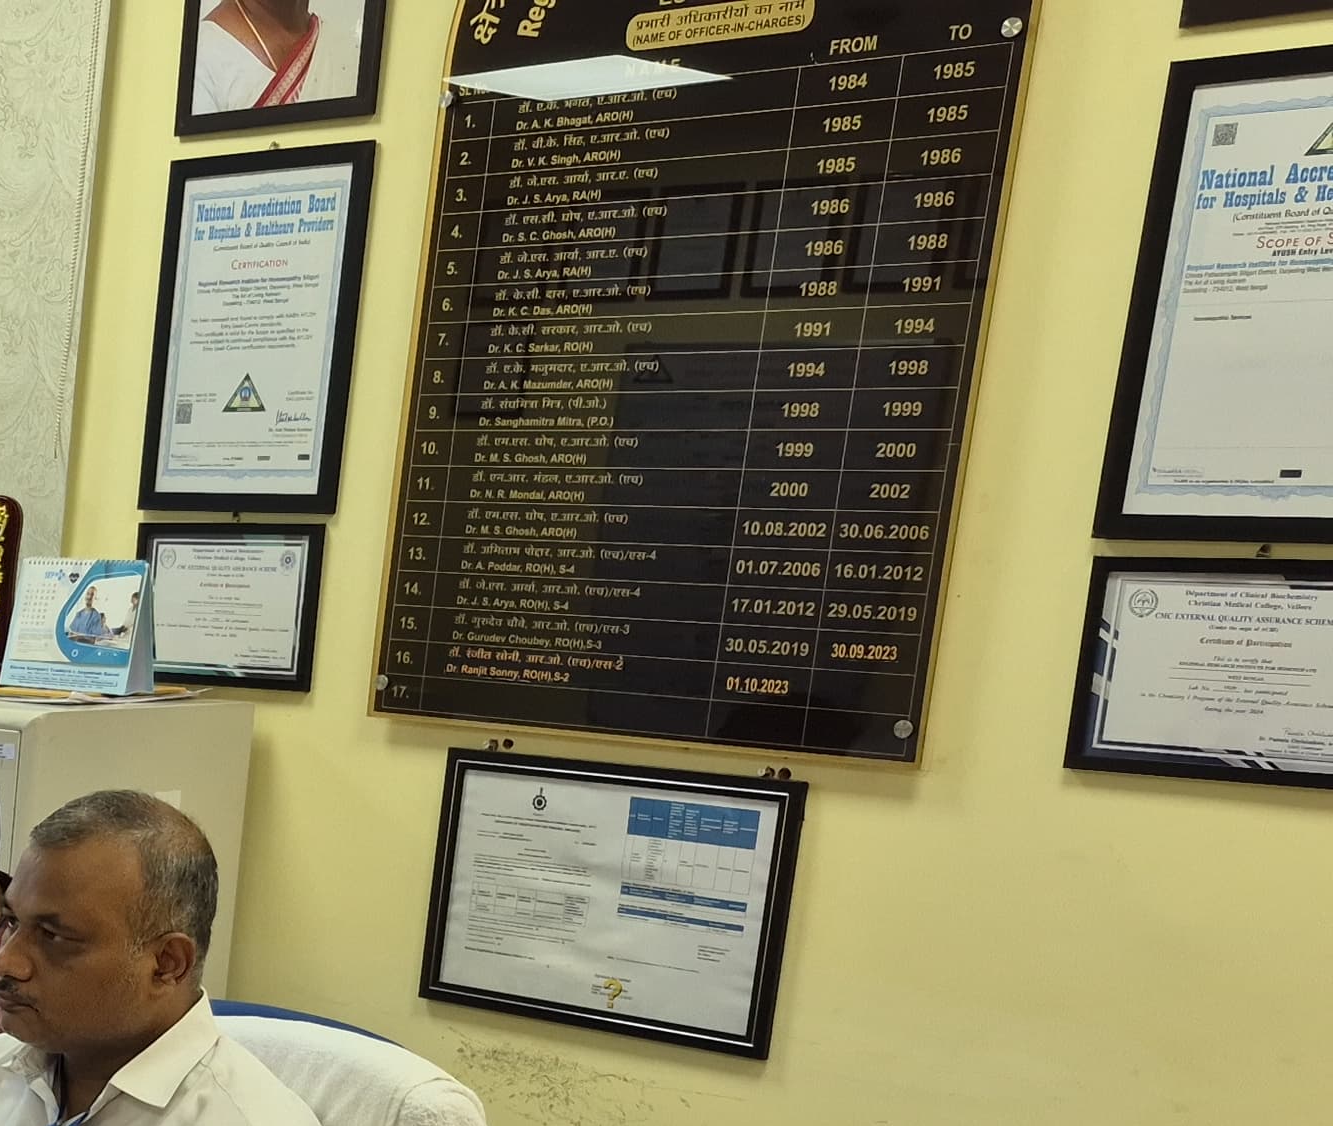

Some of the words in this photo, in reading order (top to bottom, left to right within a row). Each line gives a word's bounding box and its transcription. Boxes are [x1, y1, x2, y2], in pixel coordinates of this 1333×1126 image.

[636, 14, 670, 31] प्रभारी
[755, 4, 771, 15] का
[632, 31, 665, 47] (NAME
[668, 28, 682, 41] OF
[685, 14, 805, 39] OFFICER-IN-CHARGES)
[948, 24, 973, 40] TO
[829, 35, 878, 55] FROM
[933, 60, 976, 81] 1985
[828, 72, 868, 92] 1984
[464, 113, 476, 129] 1.
[515, 120, 530, 131] Dr.
[556, 114, 594, 128] Bhagat,
[595, 109, 634, 124] ARO(H)
[927, 104, 969, 123] 1985
[822, 114, 862, 133] 1985
[459, 151, 472, 166] 2.
[510, 158, 525, 169] Dr.
[550, 153, 582, 166] Singh,
[582, 149, 621, 163] ARO(H)
[920, 147, 962, 166] 1986
[816, 156, 857, 175] 1985
[1199, 165, 1275, 190] National
[455, 187, 467, 203] 3.
[506, 195, 520, 206] Dr.
[544, 192, 571, 203] Arya,
[572, 188, 602, 201] RA(H)
[913, 190, 956, 209] 1986
[1196, 193, 1217, 210] for
[1223, 188, 1286, 210] Hospitals
[1294, 186, 1308, 203] &
[196, 202, 234, 222] National
[240, 197, 302, 218] Accreditation
[308, 192, 336, 213] Board
[810, 198, 850, 216] 1986
[1232, 212, 1282, 223] (Constituent
[1285, 209, 1310, 218] Board
[1311, 208, 1322, 217] of
[194, 228, 205, 241] for
[208, 225, 241, 242] Hospitals
[245, 222, 251, 237] &
[255, 221, 294, 236] Healthcare
[298, 217, 334, 232] Providers
[450, 224, 463, 239] 4.
[502, 232, 516, 243] Dr.
[541, 228, 577, 241] Ghosh,
[577, 226, 616, 239] ARO(H)
[804, 239, 844, 257] 1986
[907, 233, 949, 251] 1988
[1256, 236, 1299, 249] SCOPE
[1305, 237, 1322, 247] OF
[446, 261, 458, 276] 5.
[799, 280, 838, 297] 1988
[902, 275, 942, 293] 1991
[441, 297, 454, 312] 6.
[794, 321, 831, 338] 1991
[894, 317, 935, 335] 1994
[437, 332, 450, 347] 7.
[487, 343, 501, 353] Dr.
[527, 341, 561, 352] Sarkar,
[563, 341, 594, 351] RO(H)
[787, 361, 825, 378] 1994
[888, 359, 929, 376] 1998
[432, 370, 445, 384] 8.
[428, 405, 440, 420] 9.
[781, 402, 820, 418] 1998
[882, 400, 923, 417] 1999
[478, 416, 493, 425] Dr.
[494, 416, 556, 425] Sanghamitra
[556, 415, 585, 425] Mitra,
[586, 416, 614, 425] (P.O.)
[420, 441, 439, 455] 10.
[775, 442, 814, 458] 1999
[875, 442, 917, 458] 2000
[416, 476, 435, 491] 11.
[769, 481, 809, 497] 2000
[868, 483, 911, 499] 2002
[412, 512, 431, 526] 12.
[742, 520, 827, 537] 10.08.2002
[838, 523, 930, 540] 30.06.2006
[408, 546, 426, 561] 13.
[735, 559, 821, 577] 01.07.2006
[834, 563, 924, 581] 16.01.2012
[404, 581, 422, 595] 14.
[1231, 591, 1239, 599] of
[1240, 591, 1268, 599] Clinical
[731, 598, 816, 617] 17.01.2012
[826, 602, 918, 622] 29.05.2019
[1188, 600, 1222, 608] Christian
[1225, 601, 1253, 609] Medical
[399, 616, 418, 631] 15.
[1155, 612, 1174, 620] CMC
[1175, 613, 1216, 622] EXTERNAL
[1218, 615, 1253, 623] QUALITY
[1256, 616, 1303, 625] ASSURANCE
[452, 630, 465, 640] Dr.
[466, 631, 507, 642] Gurudev
[508, 634, 552, 646] Choubey,
[724, 637, 810, 657] 30.05.2019
[830, 643, 898, 663] 30.09.2023
[395, 650, 414, 665] 16.
[391, 684, 410, 699] 17.
[726, 676, 789, 695] 01.10.2023
